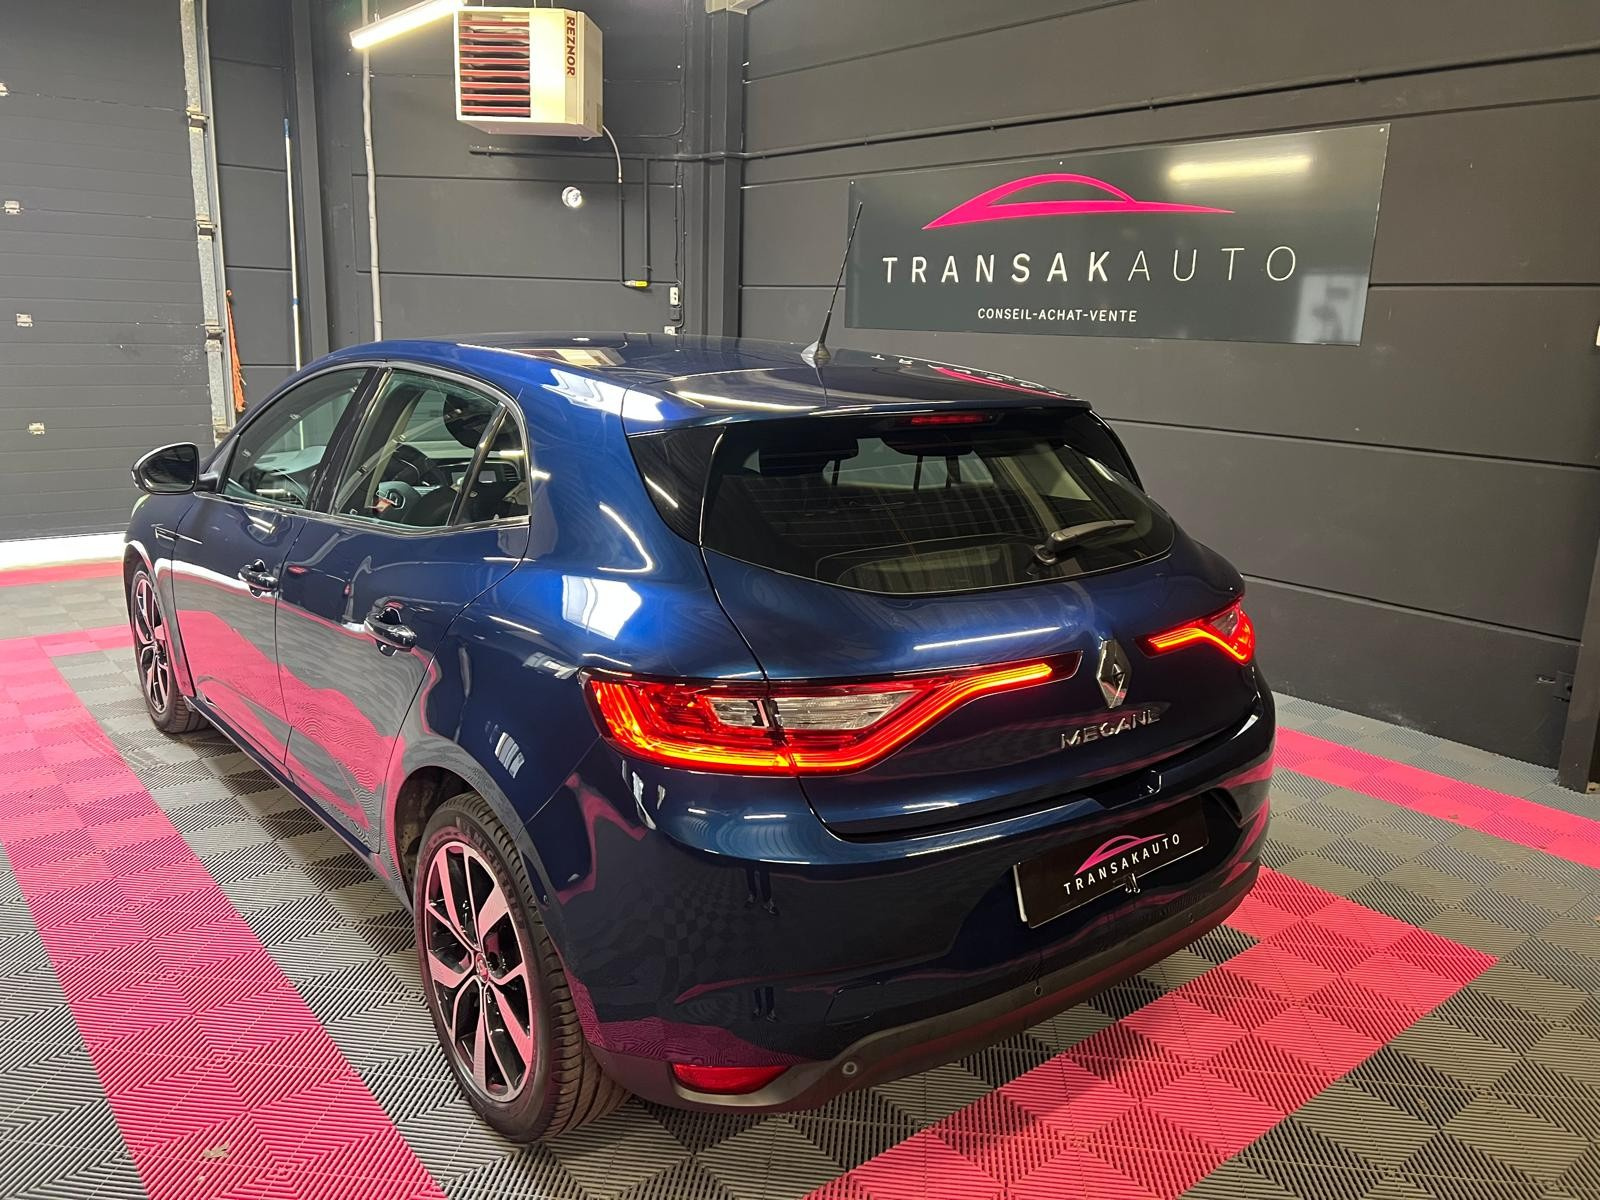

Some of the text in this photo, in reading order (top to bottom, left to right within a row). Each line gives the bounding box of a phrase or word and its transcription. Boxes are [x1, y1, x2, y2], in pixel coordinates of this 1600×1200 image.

[566, 16, 576, 76] REZNOR
[882, 246, 1296, 284] TRANSAKAUTO
[977, 307, 1138, 323] CONSEIL-ACHAT-VENTE
[1060, 709, 1161, 749] MEGANE
[1063, 833, 1180, 895] TRANSAKAUTO
